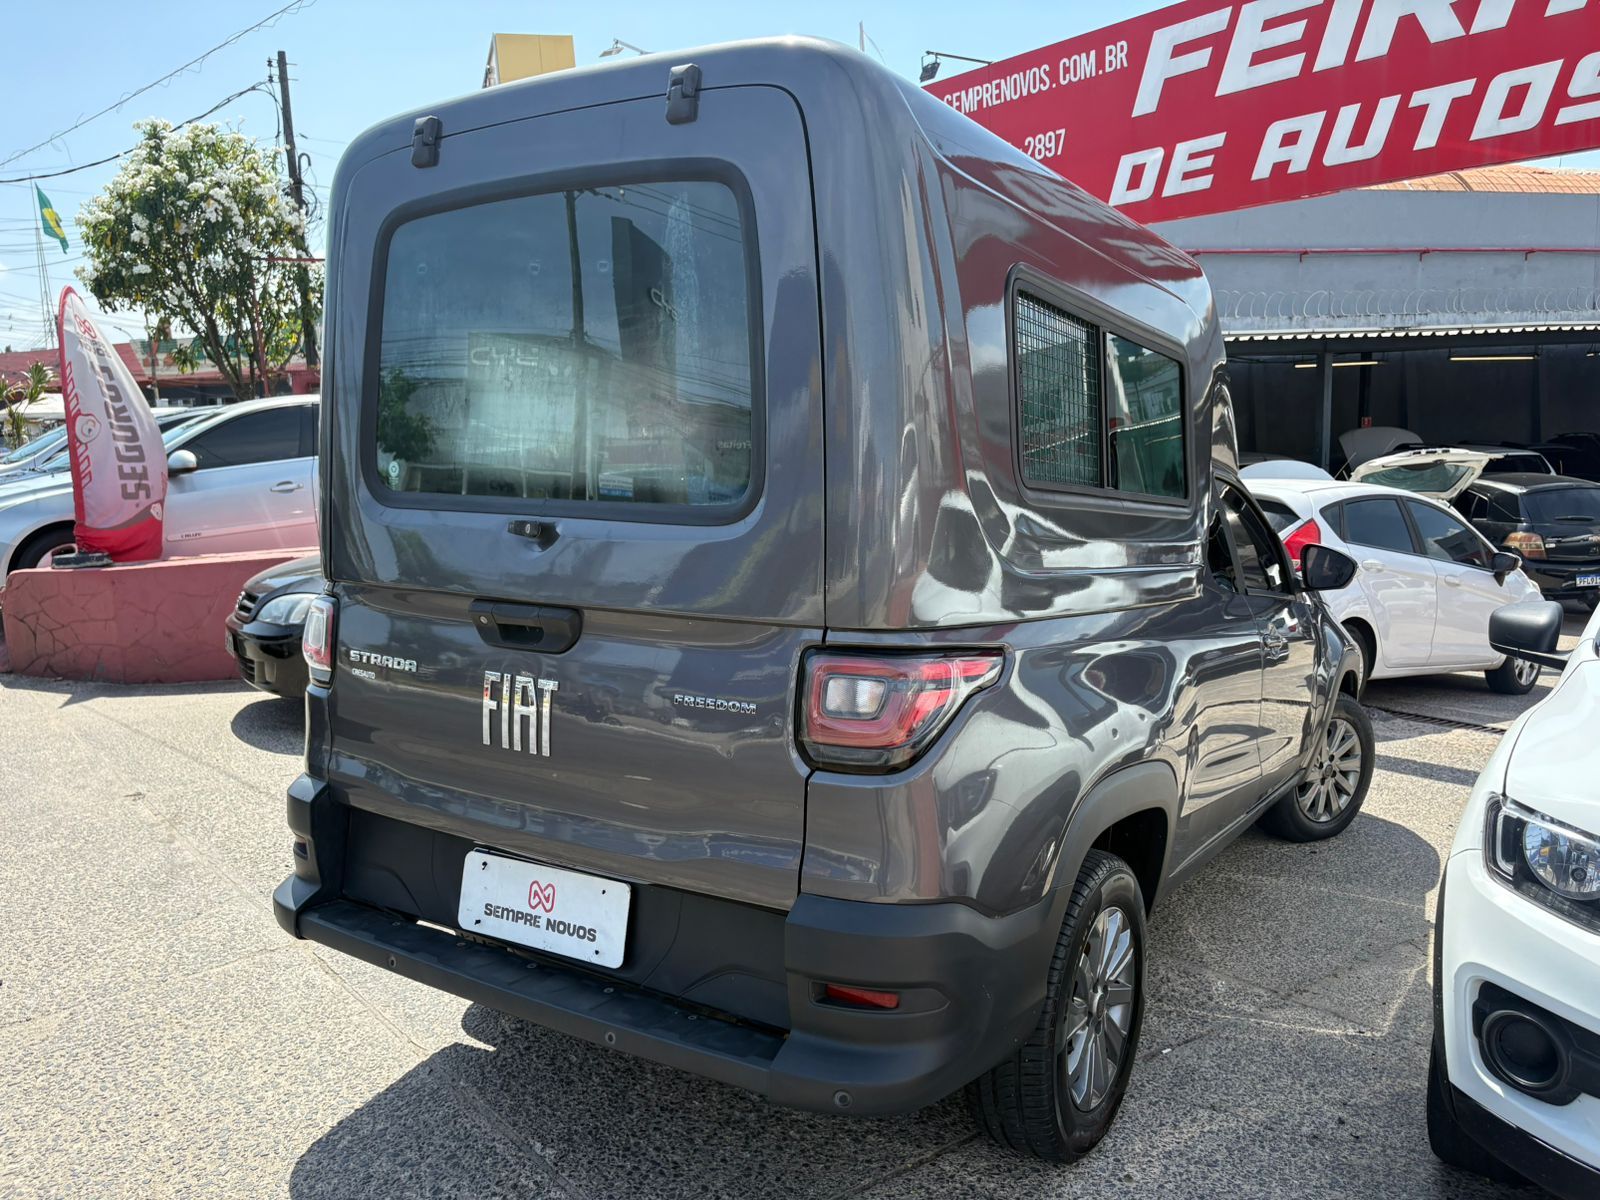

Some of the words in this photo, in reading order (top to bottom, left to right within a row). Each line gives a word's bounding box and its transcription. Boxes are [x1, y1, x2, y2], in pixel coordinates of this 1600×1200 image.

[1108, 131, 1227, 207] DE
[349, 649, 417, 673] STRADA
[482, 670, 559, 757] FIAT
[673, 693, 758, 716] FREEDOM
[483, 902, 542, 929] SEMPRE
[545, 917, 598, 943] NOVOS
